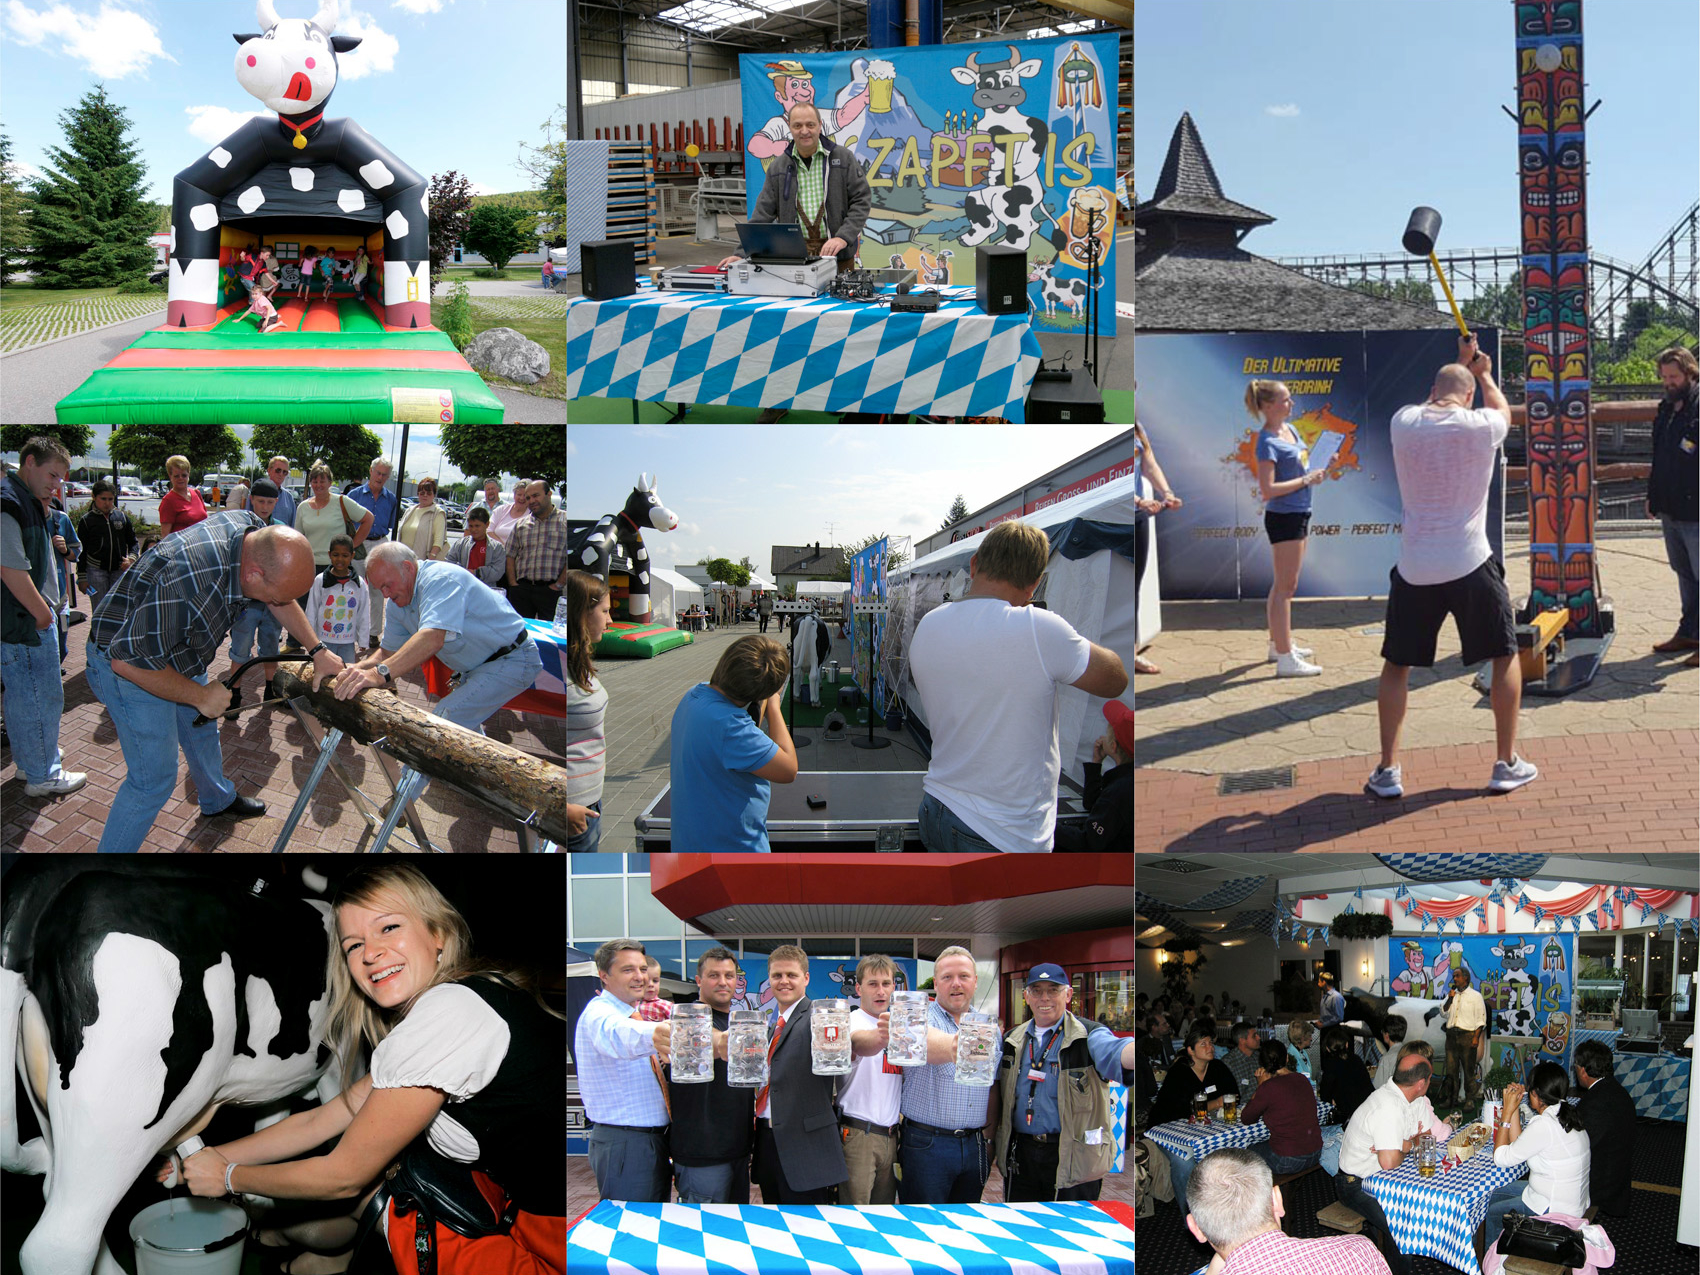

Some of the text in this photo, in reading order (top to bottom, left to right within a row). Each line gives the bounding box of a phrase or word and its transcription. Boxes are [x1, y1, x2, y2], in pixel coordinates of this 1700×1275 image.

[1044, 132, 1096, 188] IS
[1243, 357, 1343, 374] DER ULTIMATIVE
[1086, 477, 1106, 492] UND
[1310, 524, 1341, 536] POWER
[1351, 523, 1390, 535] PERFECT
[1536, 982, 1562, 1012] IS
